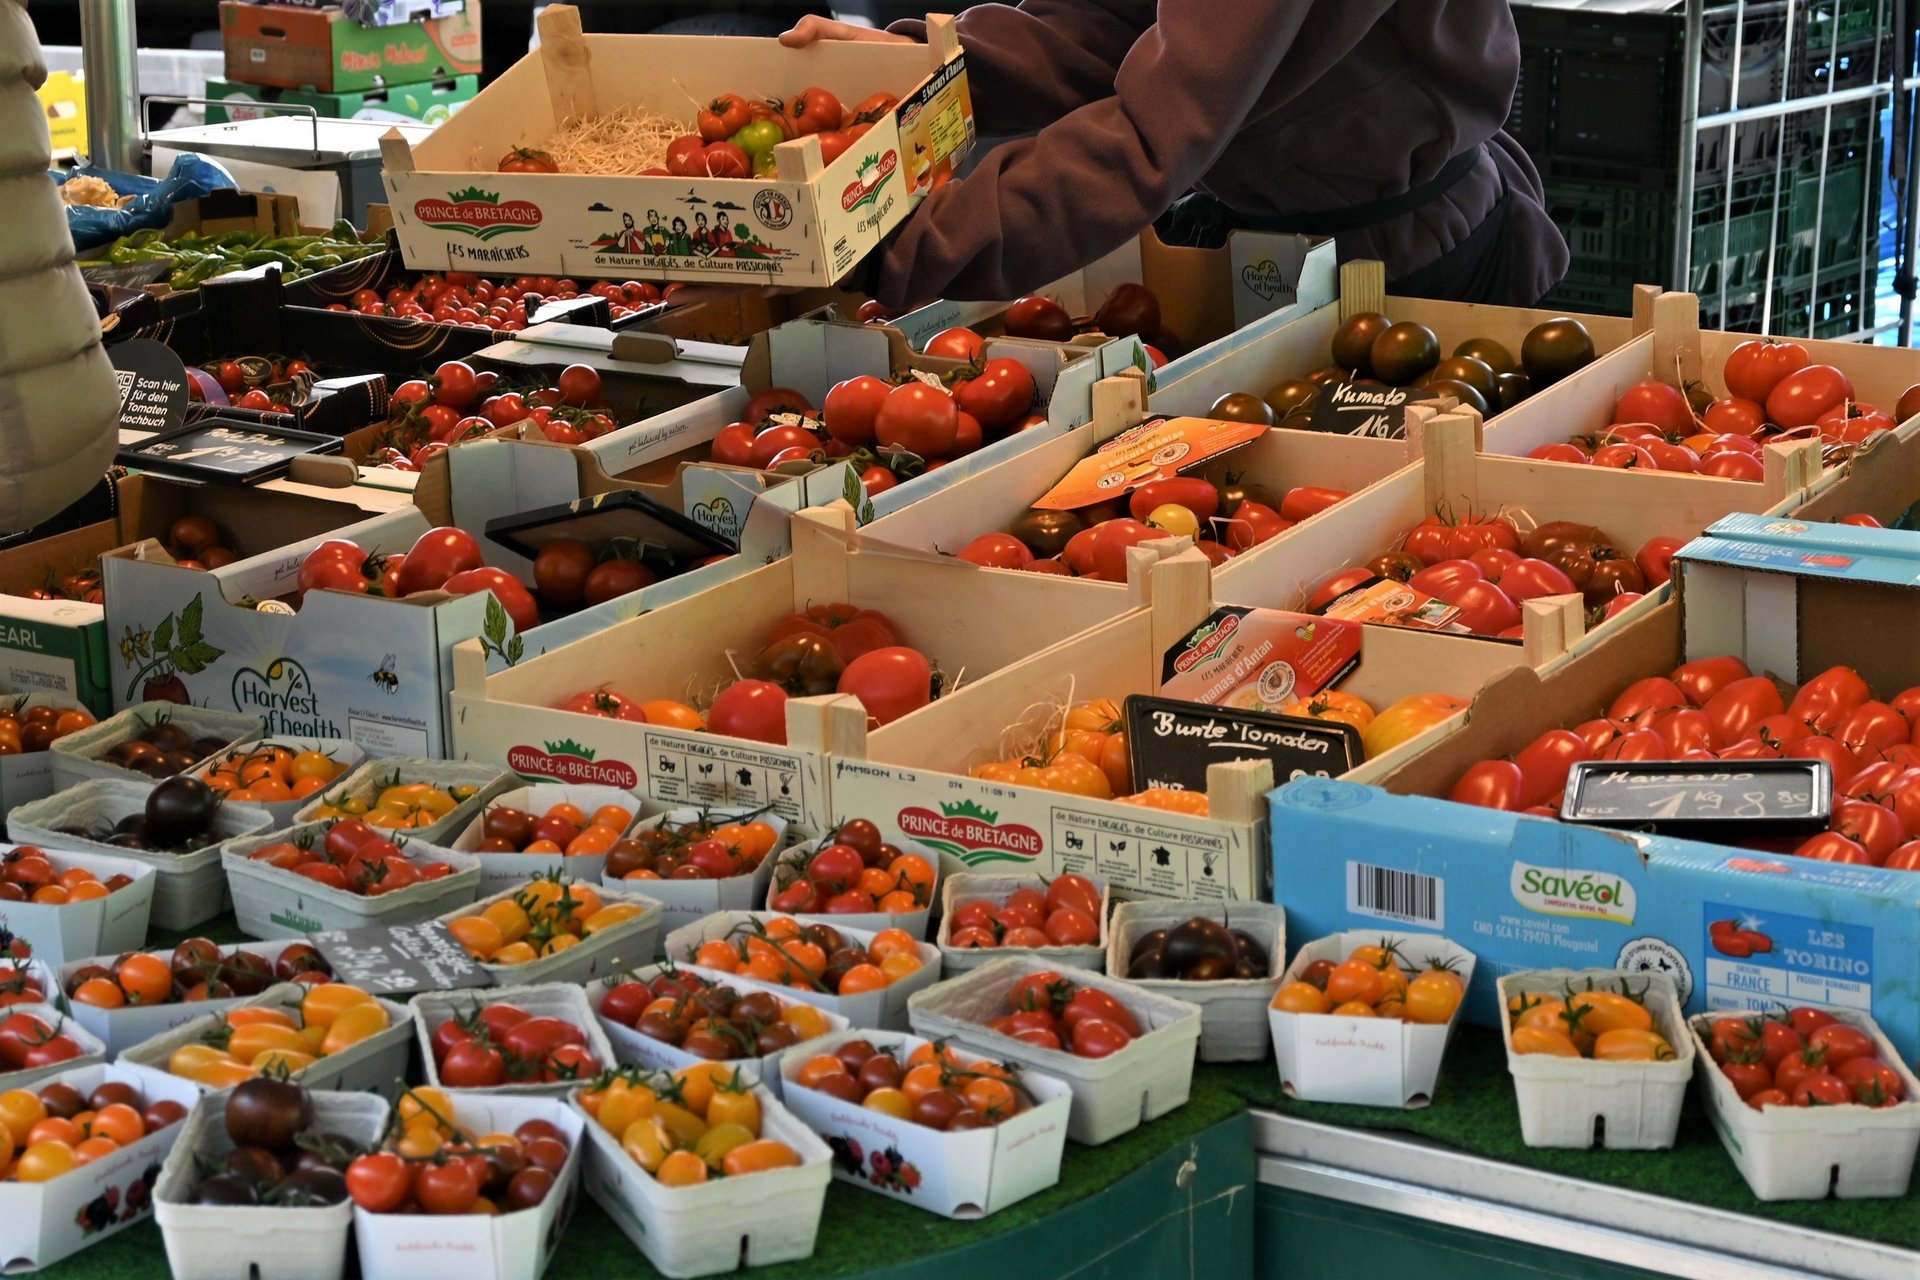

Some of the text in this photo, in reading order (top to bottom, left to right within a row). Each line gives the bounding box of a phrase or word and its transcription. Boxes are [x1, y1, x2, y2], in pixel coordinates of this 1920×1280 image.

[843, 183, 862, 207] PRINCE
[418, 206, 539, 221] PRINCE de BRETAGNE
[857, 222, 867, 233] LES
[447, 242, 530, 262] LES MARAÎCHERS
[595, 256, 606, 264] de
[609, 256, 640, 266] Nature
[684, 260, 695, 268] de
[699, 260, 733, 270] Culture
[1247, 267, 1282, 282] Harvest
[1254, 282, 1293, 294] of health
[137, 377, 180, 392] Scan hier
[1331, 382, 1407, 406] Kumato
[131, 389, 168, 403] für dein
[127, 402, 168, 415] Tomaten
[120, 413, 166, 427] kochbuch
[697, 507, 738, 525] Harvest
[1177, 617, 1238, 671] PRINCE de BRETAGNE
[1201, 667, 1215, 681] LES
[1213, 643, 1245, 674] MARAÎCHERS
[1235, 638, 1273, 677] d'Antan
[243, 675, 320, 717] Harvest
[280, 714, 342, 740] health
[1152, 711, 1329, 754] Bunte Tomaten
[650, 737, 659, 746] de
[661, 739, 686, 750] Nature
[719, 749, 729, 757] de
[730, 749, 758, 762] Culture
[511, 753, 554, 773] PRINCE
[556, 761, 567, 774] de
[568, 762, 633, 785] BRETAGNE
[899, 773, 916, 783] L3
[1601, 771, 1755, 786] Marzano
[1646, 790, 1687, 818] 1
[901, 814, 1039, 852] PRINCE de BRETAGNE
[1056, 811, 1066, 820] de
[1068, 813, 1096, 826] Nature
[1135, 825, 1145, 834] de
[1147, 827, 1178, 840] Culture
[1521, 868, 1625, 908] Savéol
[1500, 914, 1570, 934] www.saveol.com
[1553, 932, 1599, 953] Plougastel
[1808, 928, 1845, 949] LES
[1784, 948, 1870, 976] TORINO
[1727, 972, 1771, 993] FRANCE
